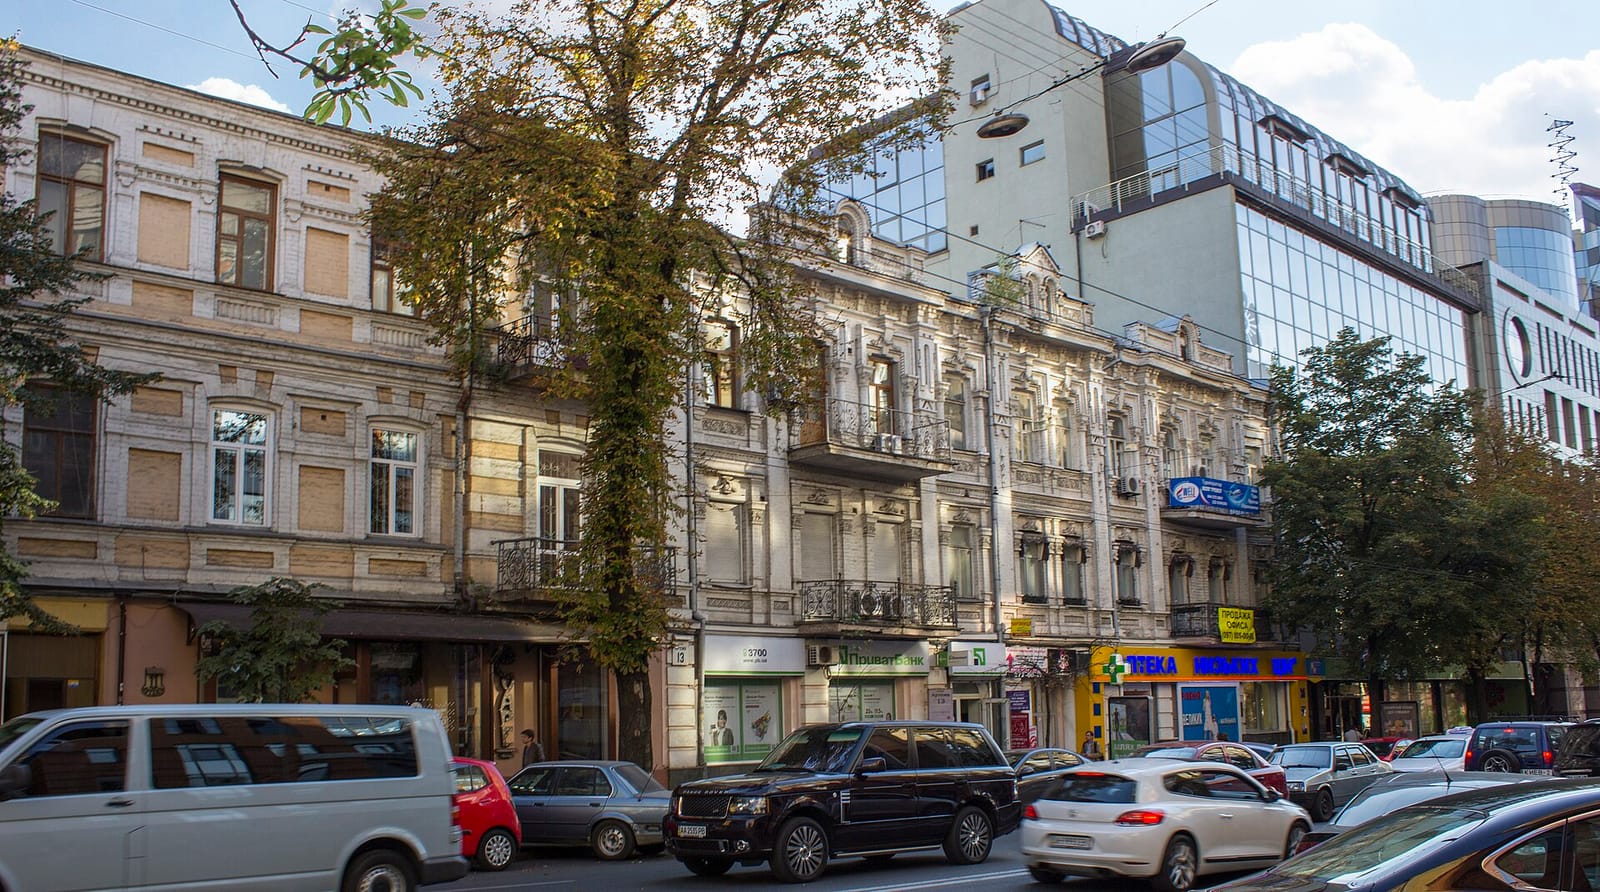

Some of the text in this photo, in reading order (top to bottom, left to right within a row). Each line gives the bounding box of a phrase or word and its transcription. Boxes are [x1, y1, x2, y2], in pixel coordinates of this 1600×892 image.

[1221, 610, 1251, 620] ПРОДАЖА
[1226, 621, 1249, 630] ОФИСА
[677, 652, 685, 664] 13
[747, 648, 768, 657] 3700
[849, 652, 925, 667] ПриватБанк
[1127, 655, 1178, 675] ПТЕКА
